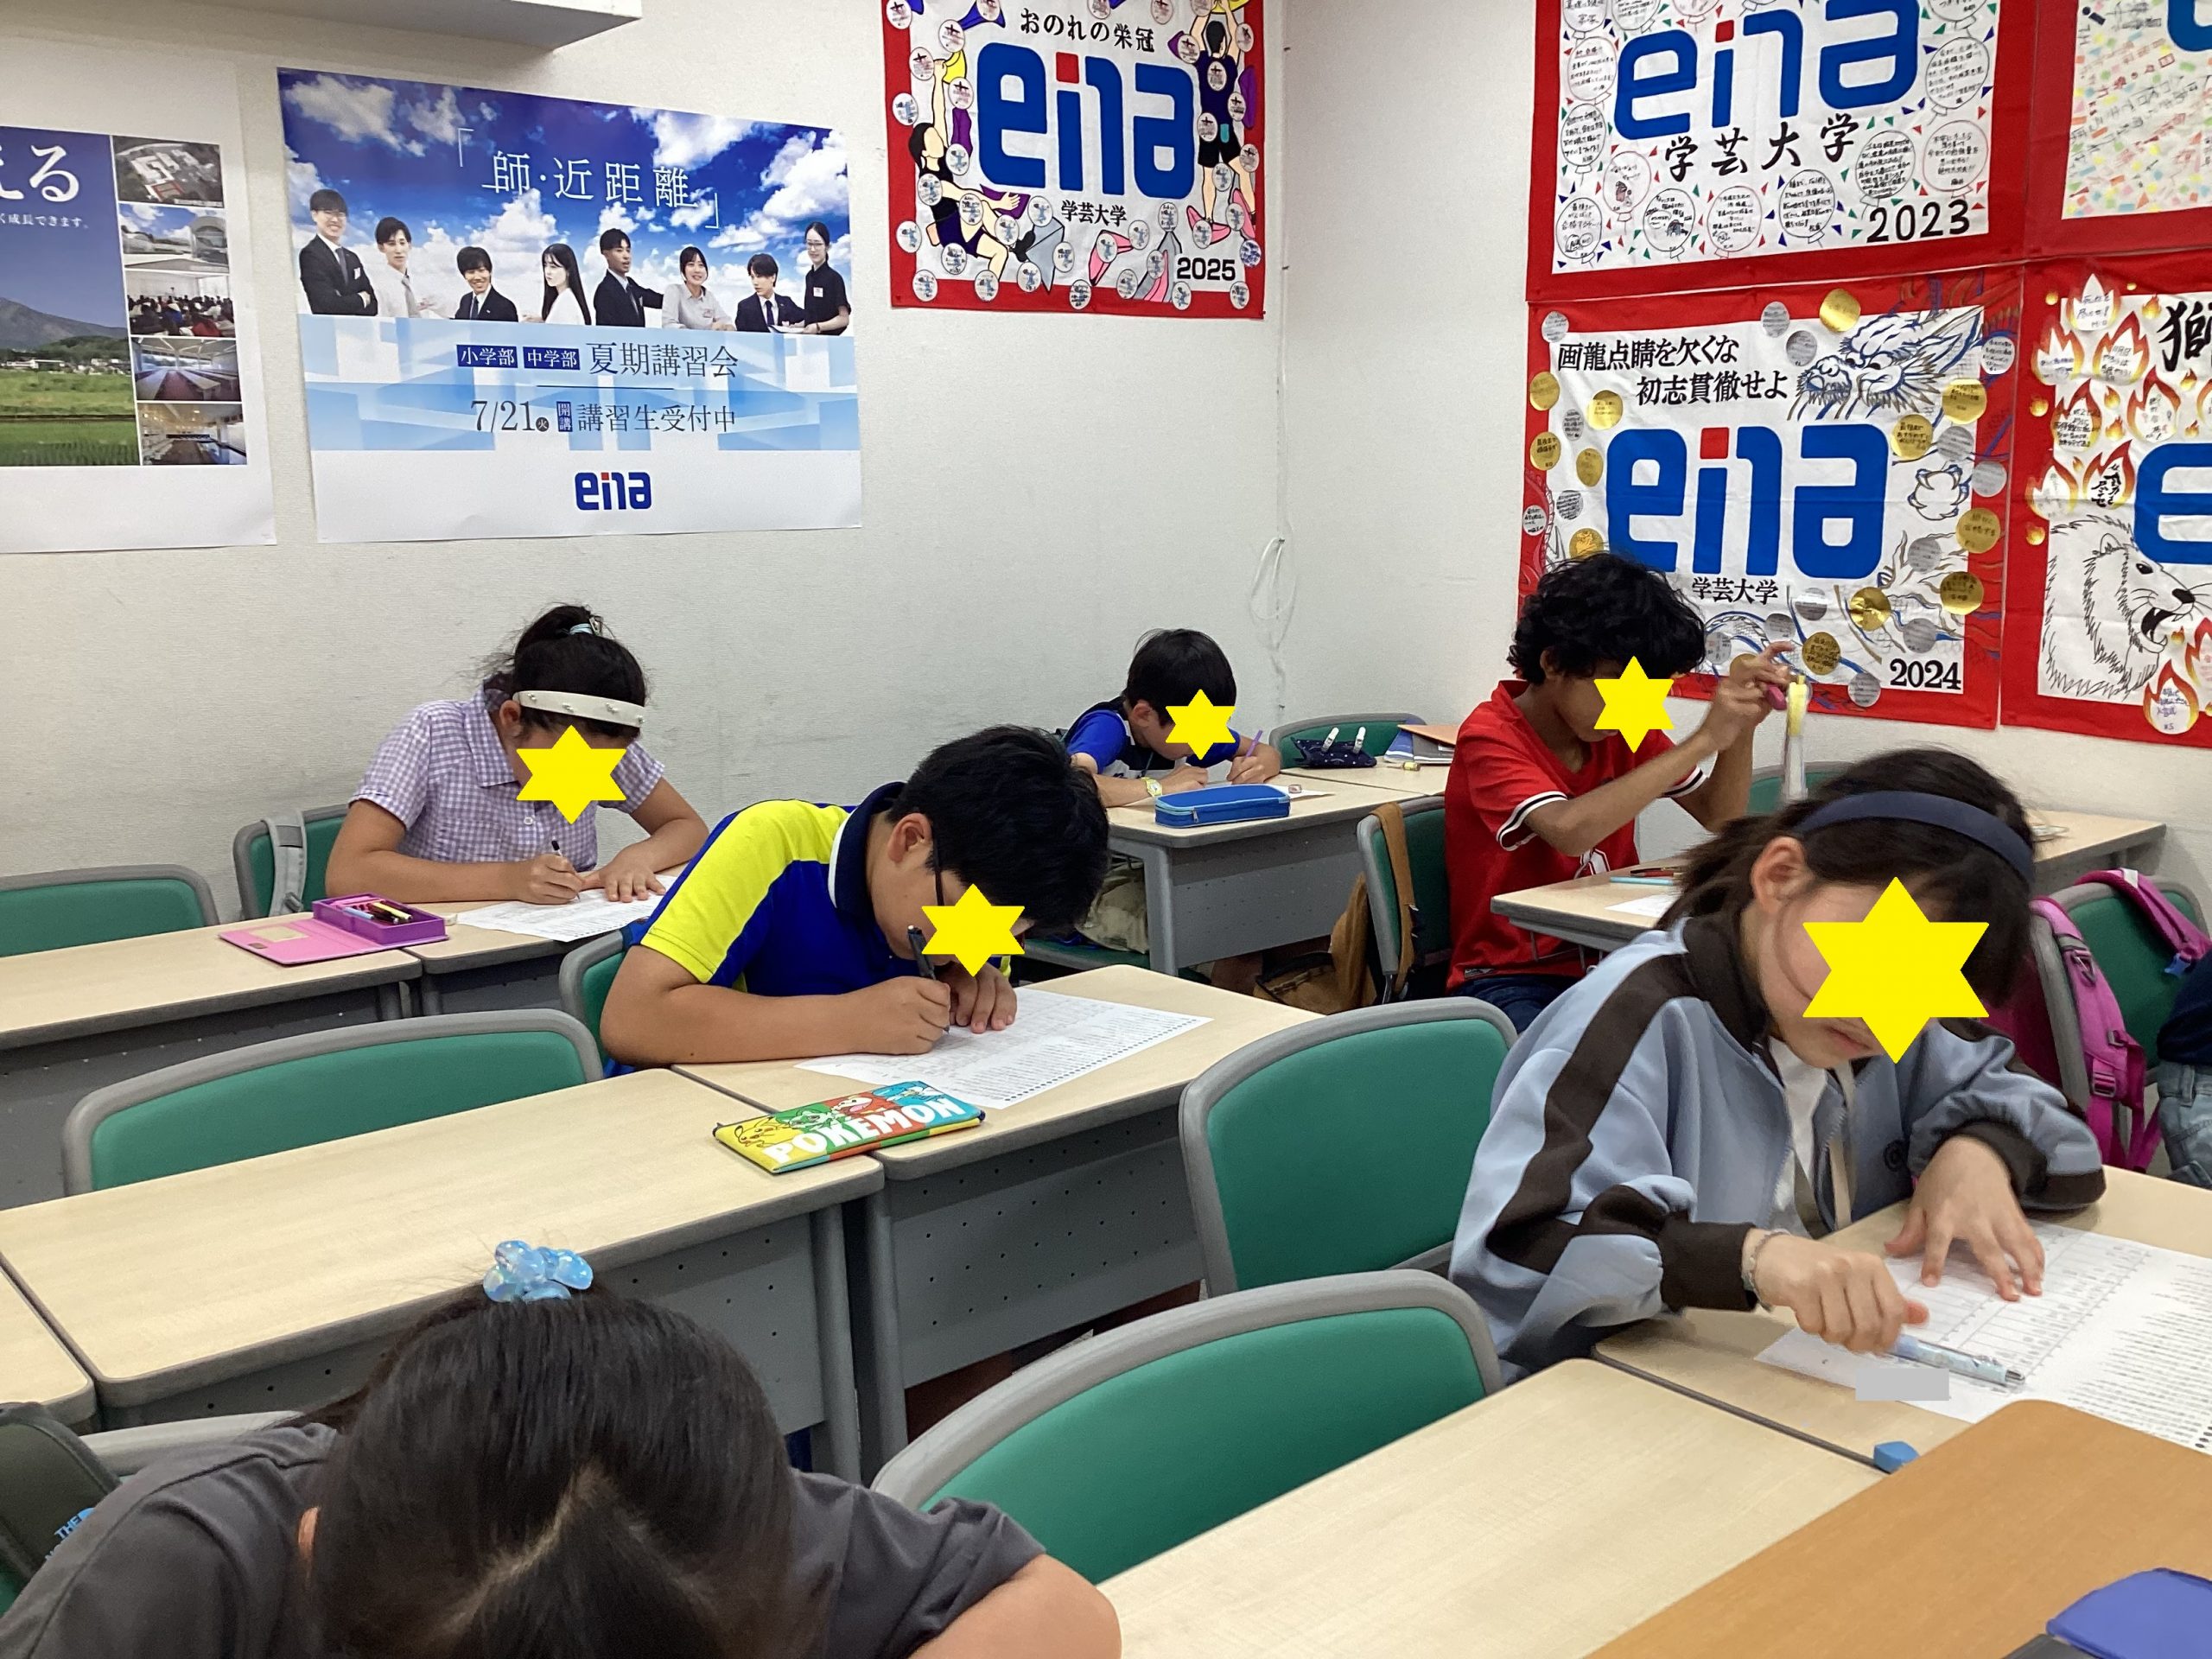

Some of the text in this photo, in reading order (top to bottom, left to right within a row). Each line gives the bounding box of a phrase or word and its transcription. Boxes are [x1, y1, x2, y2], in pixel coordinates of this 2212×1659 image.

[1020, 9, 1154, 53] おのれの栄冠
[1664, 113, 1859, 181] 学芸大学
[1059, 200, 1127, 226] 学芸大学
[1866, 199, 1971, 243] 2023
[1177, 257, 1236, 282] 2025
[461, 342, 739, 378] 小学部 中学部 夏期講習会
[1636, 370, 1788, 406] 初志貫徹せよ
[576, 404, 736, 433] 講習生受付中
[1691, 576, 1778, 605] 学芸大学
[1890, 658, 1962, 690] 2024
[764, 1100, 965, 1163] POKEMON
